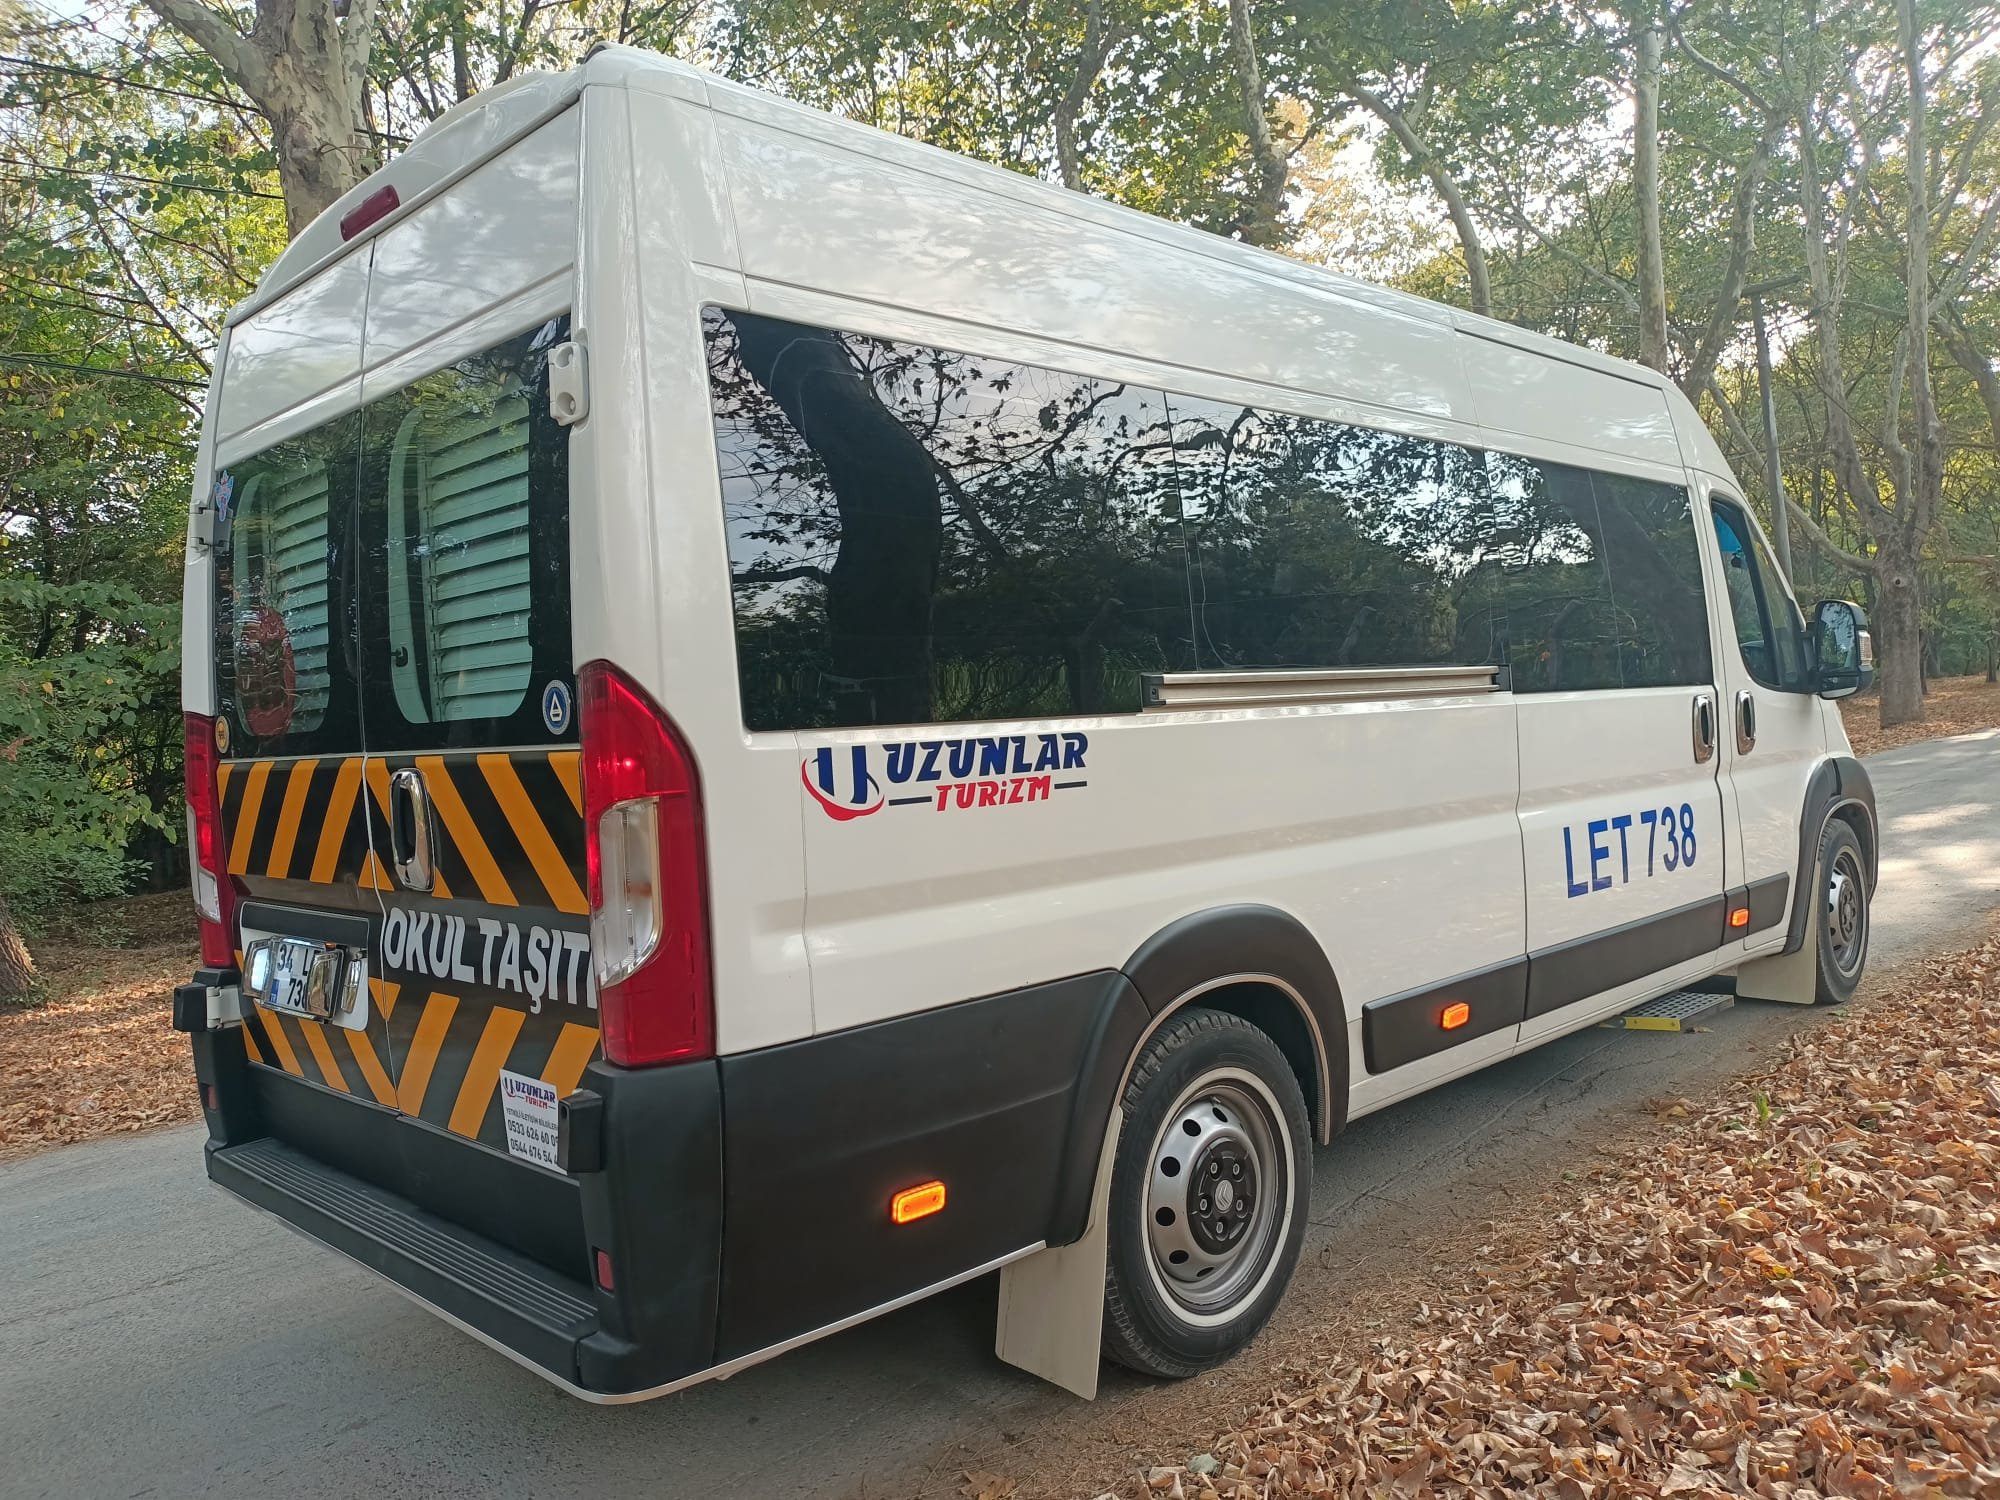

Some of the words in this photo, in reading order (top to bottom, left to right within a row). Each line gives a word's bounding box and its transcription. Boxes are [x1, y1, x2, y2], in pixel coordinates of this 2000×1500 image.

[882, 731, 1089, 784] UZUNLAR
[1563, 814, 1632, 899] LET
[1640, 802, 1697, 877] 738
[276, 943, 295, 973] 34
[384, 906, 475, 984] OKUL
[514, 1080, 556, 1103] UZUNLAR
[508, 1119, 525, 1136] 0533
[543, 1150, 553, 1164] 54
